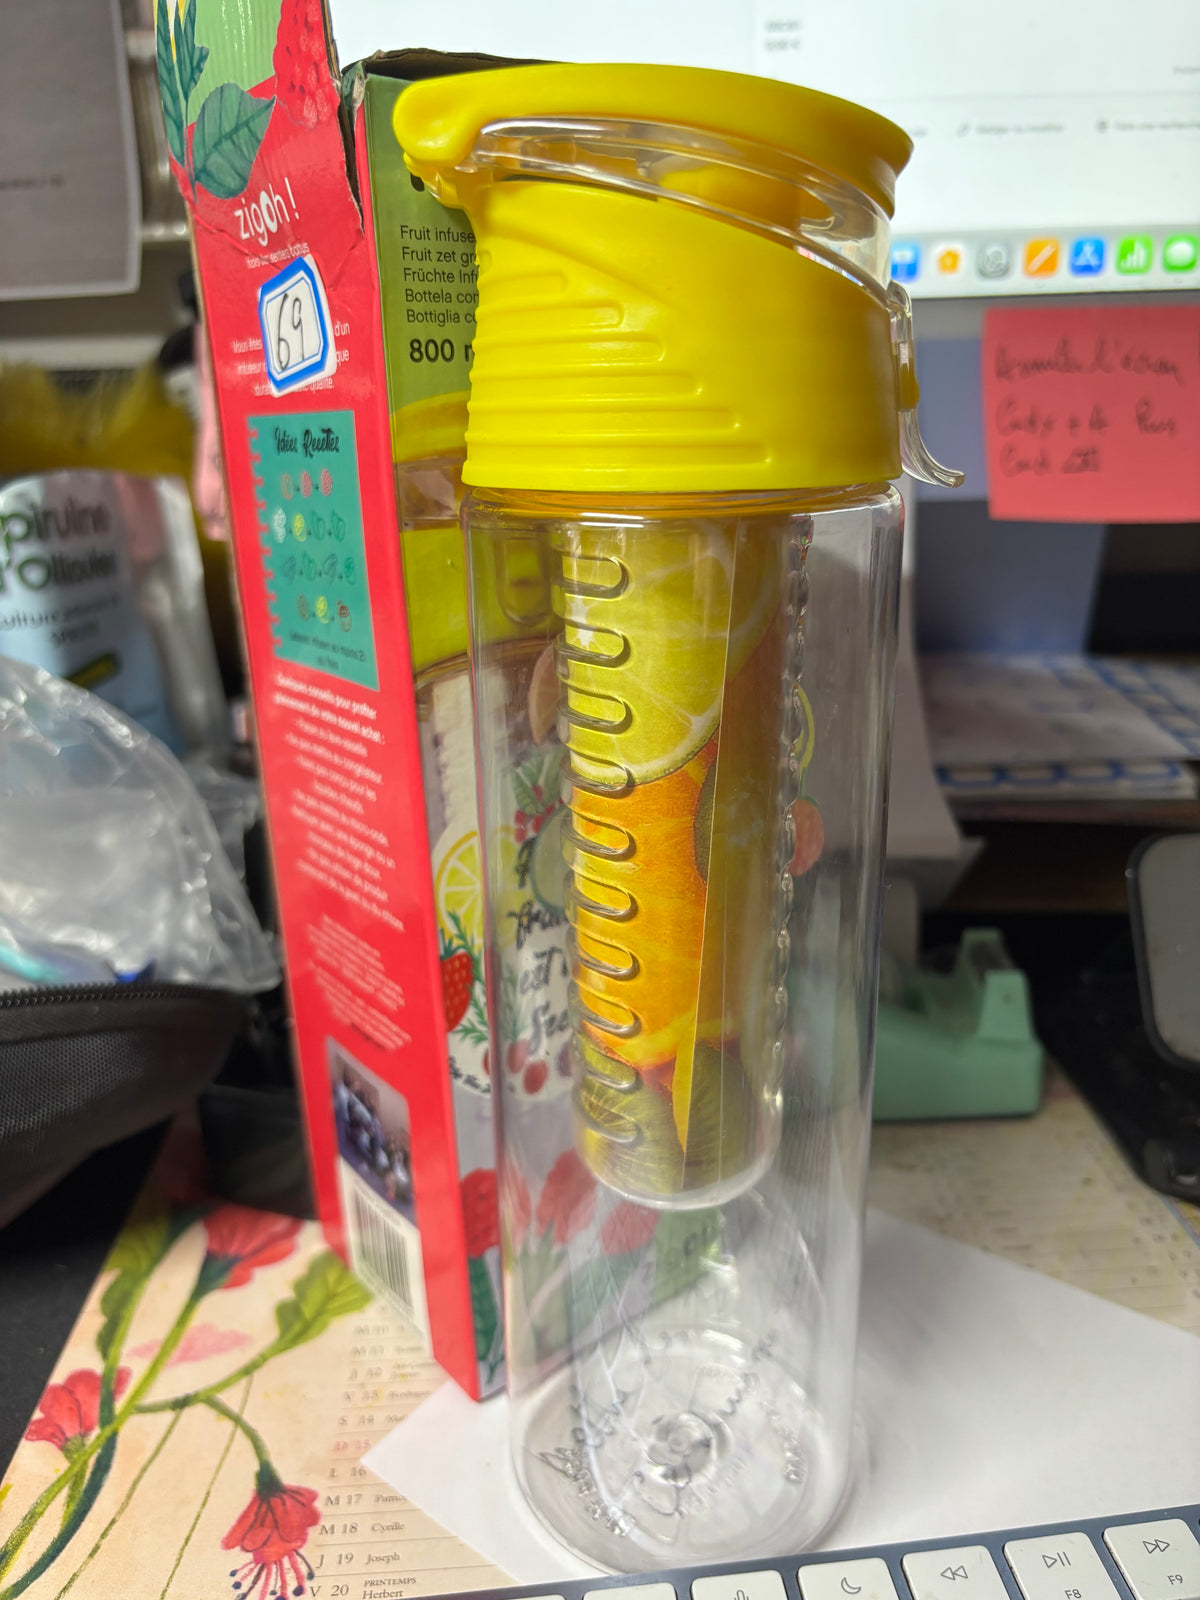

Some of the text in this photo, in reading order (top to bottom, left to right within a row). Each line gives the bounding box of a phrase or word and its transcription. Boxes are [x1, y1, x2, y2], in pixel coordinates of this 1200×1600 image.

[400, 225, 476, 243] Fruit infuse
[402, 247, 476, 267] Fruit zet gr
[404, 268, 455, 283] Früchte
[405, 288, 452, 304] Bottela
[407, 309, 478, 327] Bottiglia co
[276, 292, 305, 370] 69
[409, 338, 455, 363] 800
[350, 1466, 367, 1477] 16
[324, 1495, 340, 1506] M
[346, 1493, 363, 1504] 17
[319, 1522, 405, 1535] M 18 Cyrille
[315, 1552, 400, 1569] J 19 Joseph
[309, 1577, 417, 1597] V 20 PRINTEMPS
[1167, 1574, 1184, 1586] F9
[362, 1589, 404, 1600] Herbert
[1064, 1588, 1082, 1600] F8
